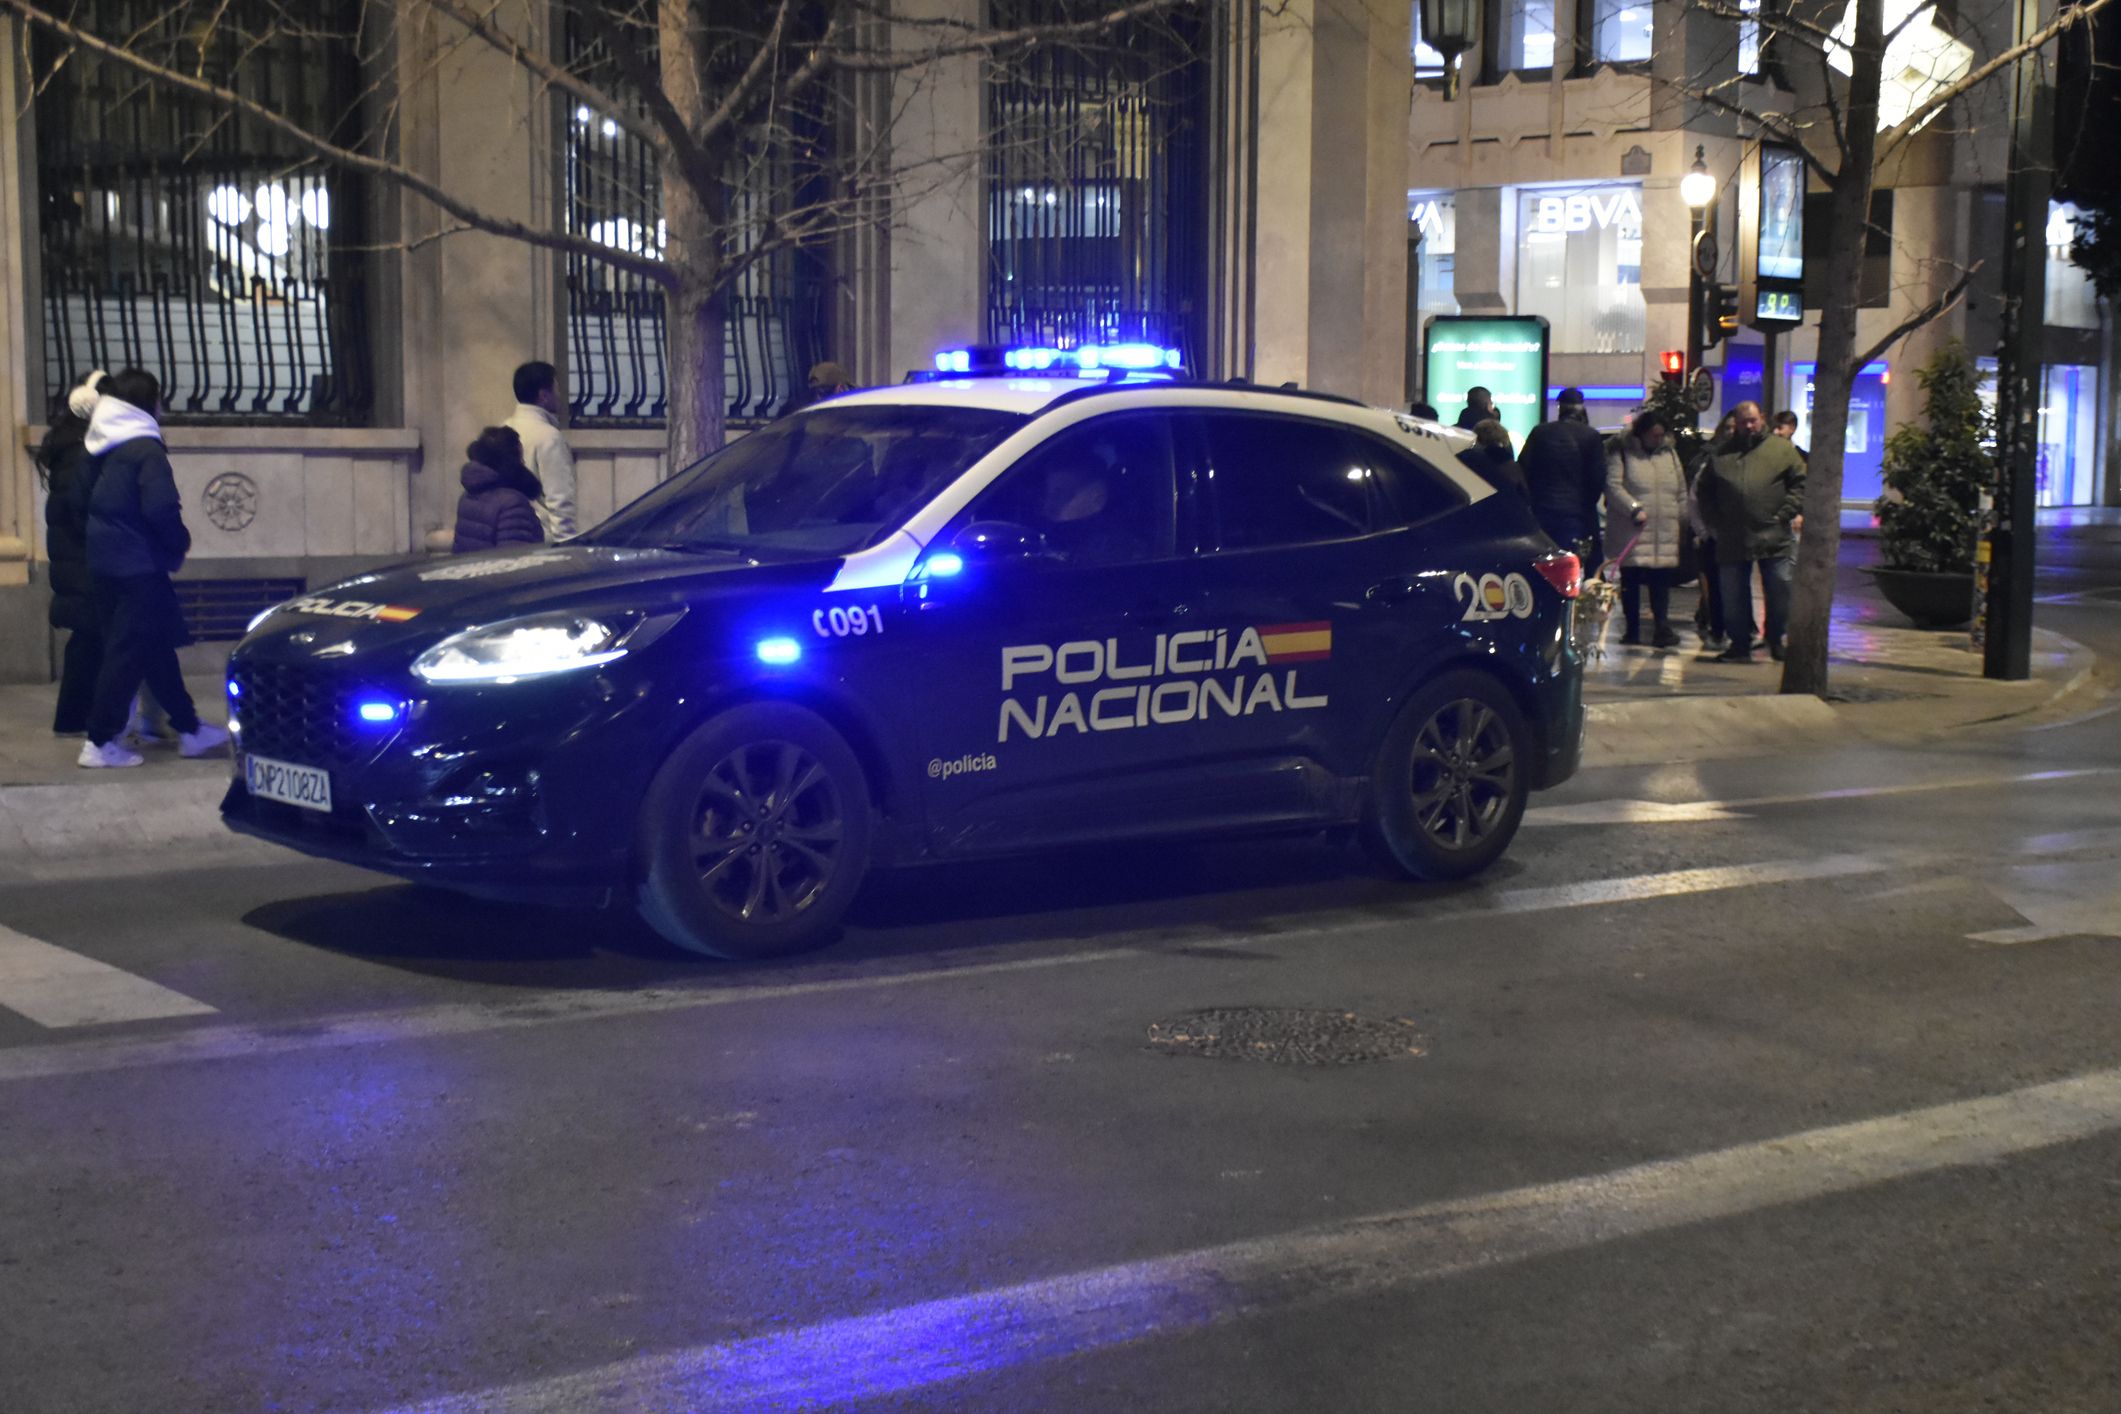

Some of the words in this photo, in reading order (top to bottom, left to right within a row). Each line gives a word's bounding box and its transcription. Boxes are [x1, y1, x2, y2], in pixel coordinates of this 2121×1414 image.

[1537, 190, 1643, 233] BBVA
[1454, 572, 1534, 621] 200
[997, 669, 1328, 743] NACIONAL
[927, 752, 997, 781] @policia
